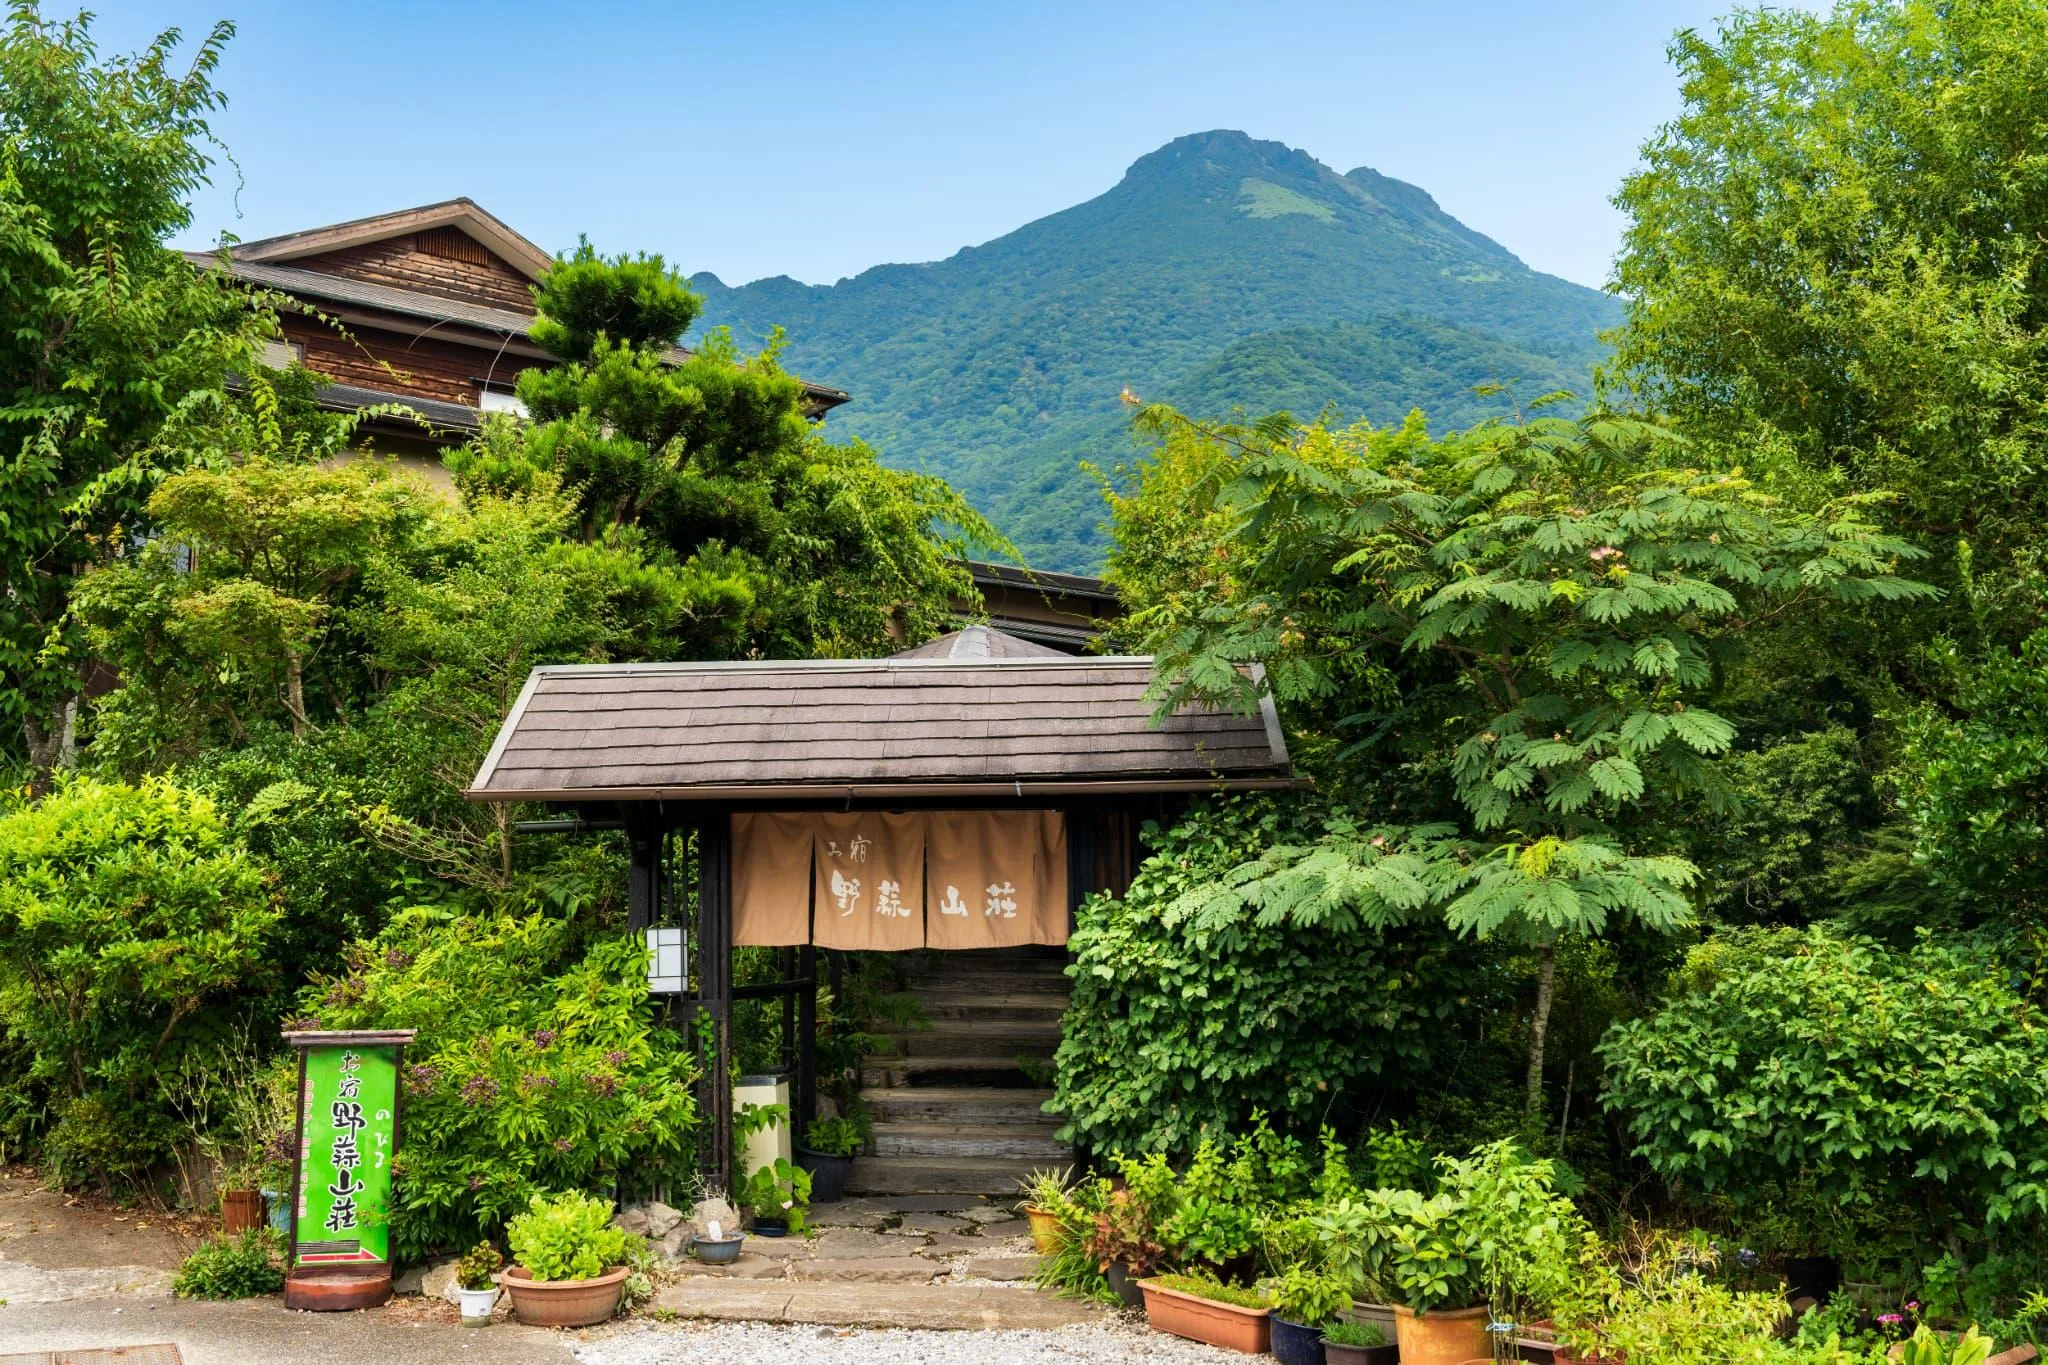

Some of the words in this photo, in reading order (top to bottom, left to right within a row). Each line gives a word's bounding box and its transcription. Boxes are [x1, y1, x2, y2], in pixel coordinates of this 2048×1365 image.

[831, 869, 1017, 918] 野蒜山荘
[374, 1109, 391, 1169] のびる
